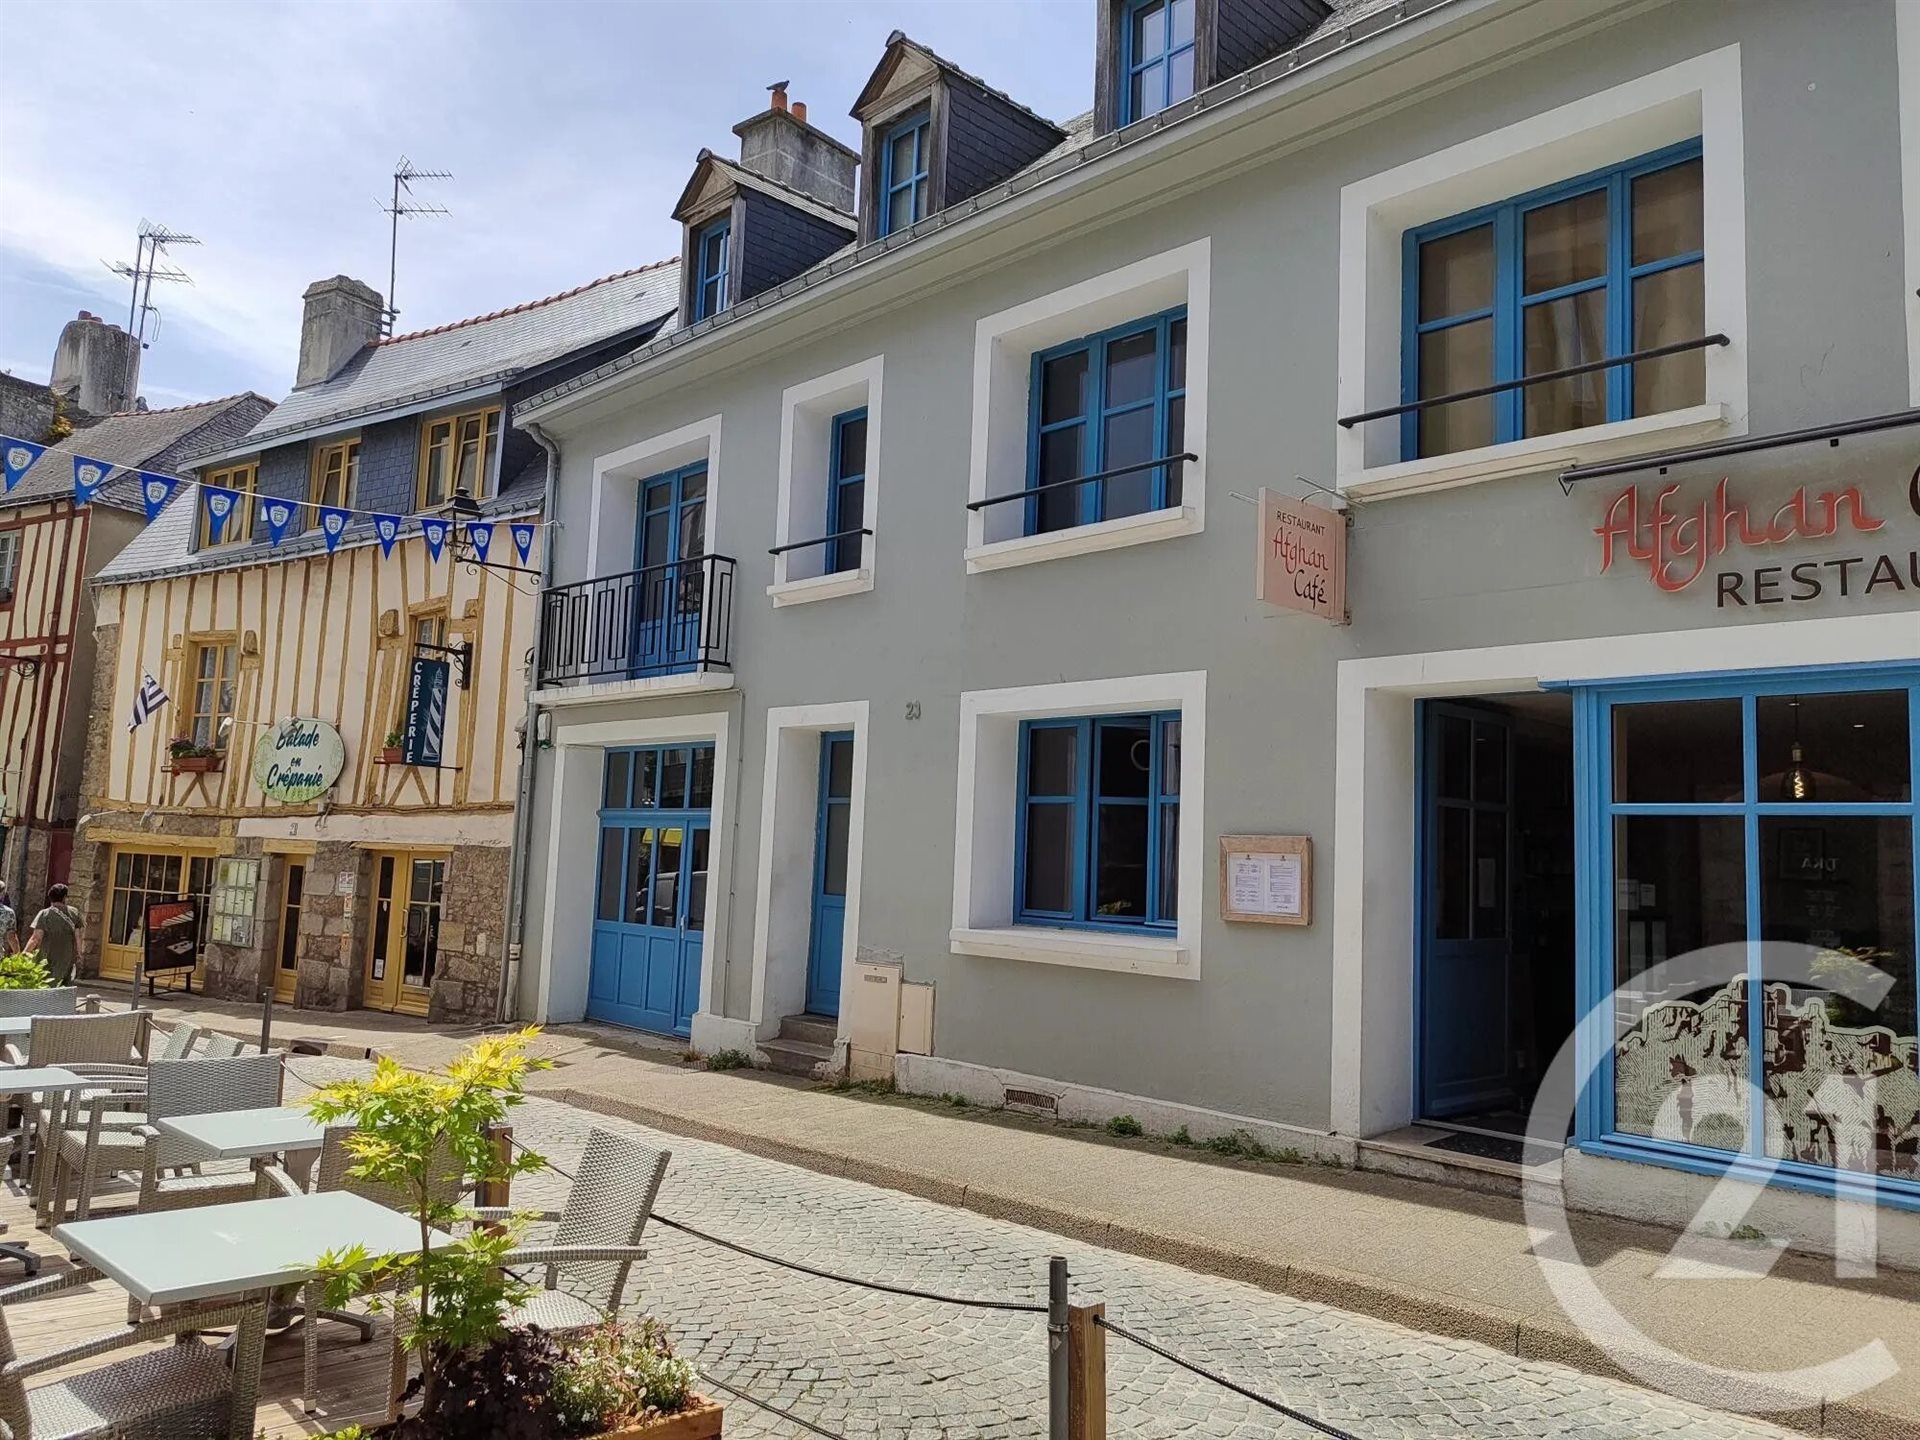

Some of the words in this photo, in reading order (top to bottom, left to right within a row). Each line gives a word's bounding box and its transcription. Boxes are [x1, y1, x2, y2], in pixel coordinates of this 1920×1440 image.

[1276, 510, 1326, 537] RESTAURANT
[1592, 476, 1888, 593] Afghan
[1273, 526, 1329, 575] Afghan
[1293, 569, 1328, 610] Café
[290, 757, 302, 768] en
